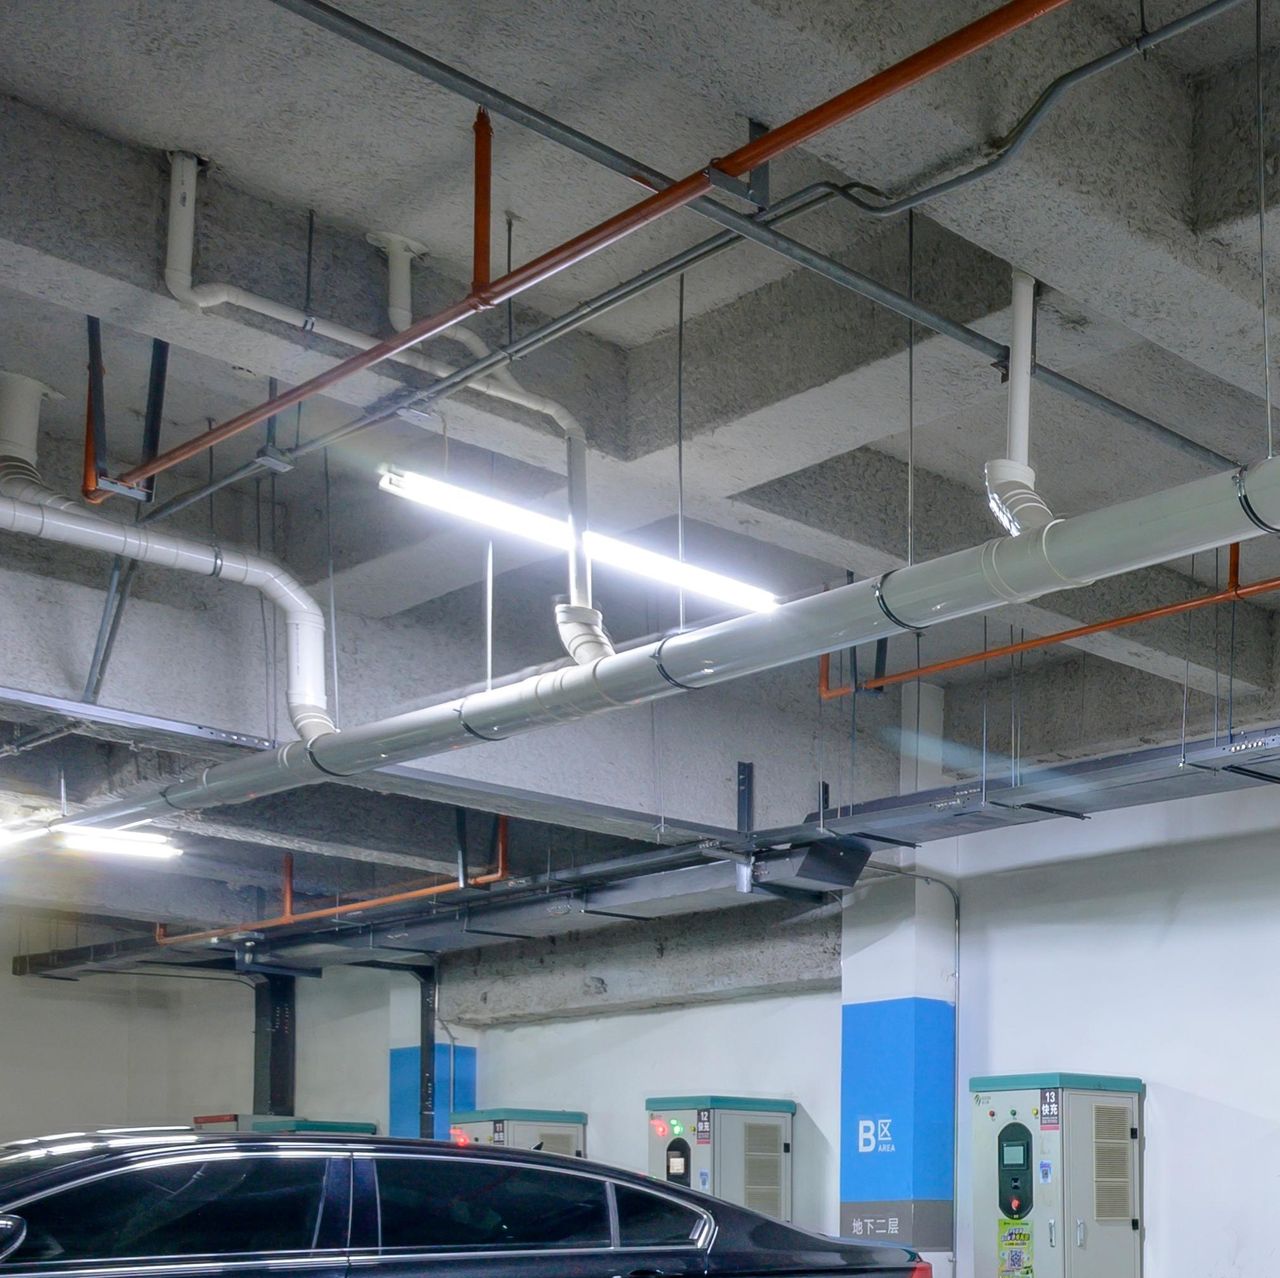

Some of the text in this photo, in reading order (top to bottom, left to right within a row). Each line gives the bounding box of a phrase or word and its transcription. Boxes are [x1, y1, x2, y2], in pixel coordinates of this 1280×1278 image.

[1045, 1091, 1056, 1103] 13
[1041, 1103, 1058, 1116] 快充
[700, 1111, 709, 1121] 12
[877, 1143, 896, 1152] AREA
[852, 1217, 899, 1235] 地下二层
